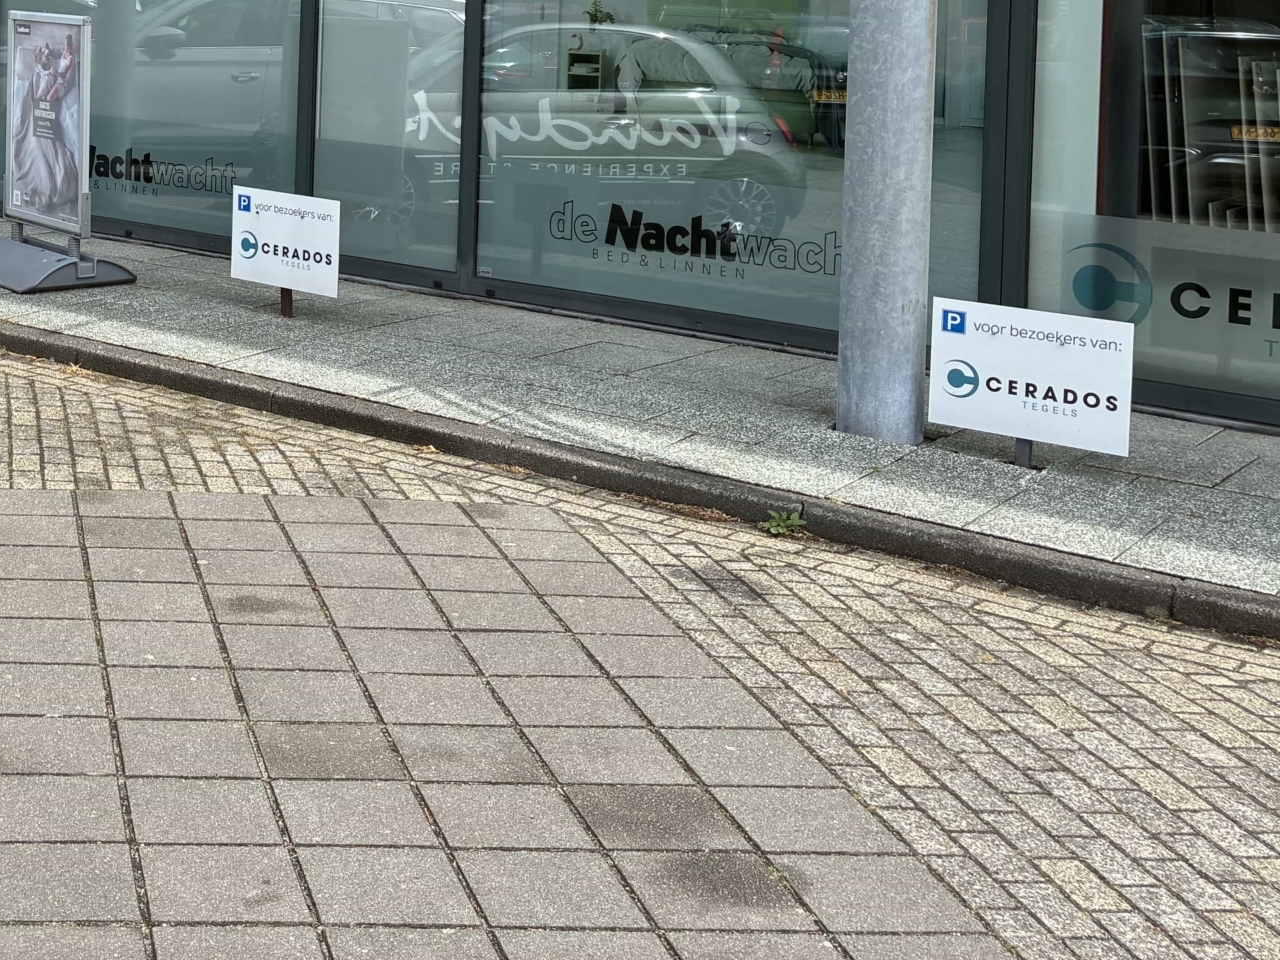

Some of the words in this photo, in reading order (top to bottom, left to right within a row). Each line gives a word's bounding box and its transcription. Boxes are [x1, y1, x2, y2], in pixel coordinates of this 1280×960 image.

[254, 202, 273, 212] voor
[273, 204, 316, 219] bezoekers
[317, 212, 335, 223] van:
[549, 200, 598, 243] de
[604, 203, 843, 276] Nachtwach
[261, 242, 333, 266] CERADOS
[280, 260, 312, 271] TEGELS
[973, 321, 1007, 335] voor
[1009, 324, 1087, 347] bezoekers
[1090, 339, 1123, 352] van:
[985, 376, 1119, 412] CERADOS
[1021, 401, 1079, 418] TEGELS
